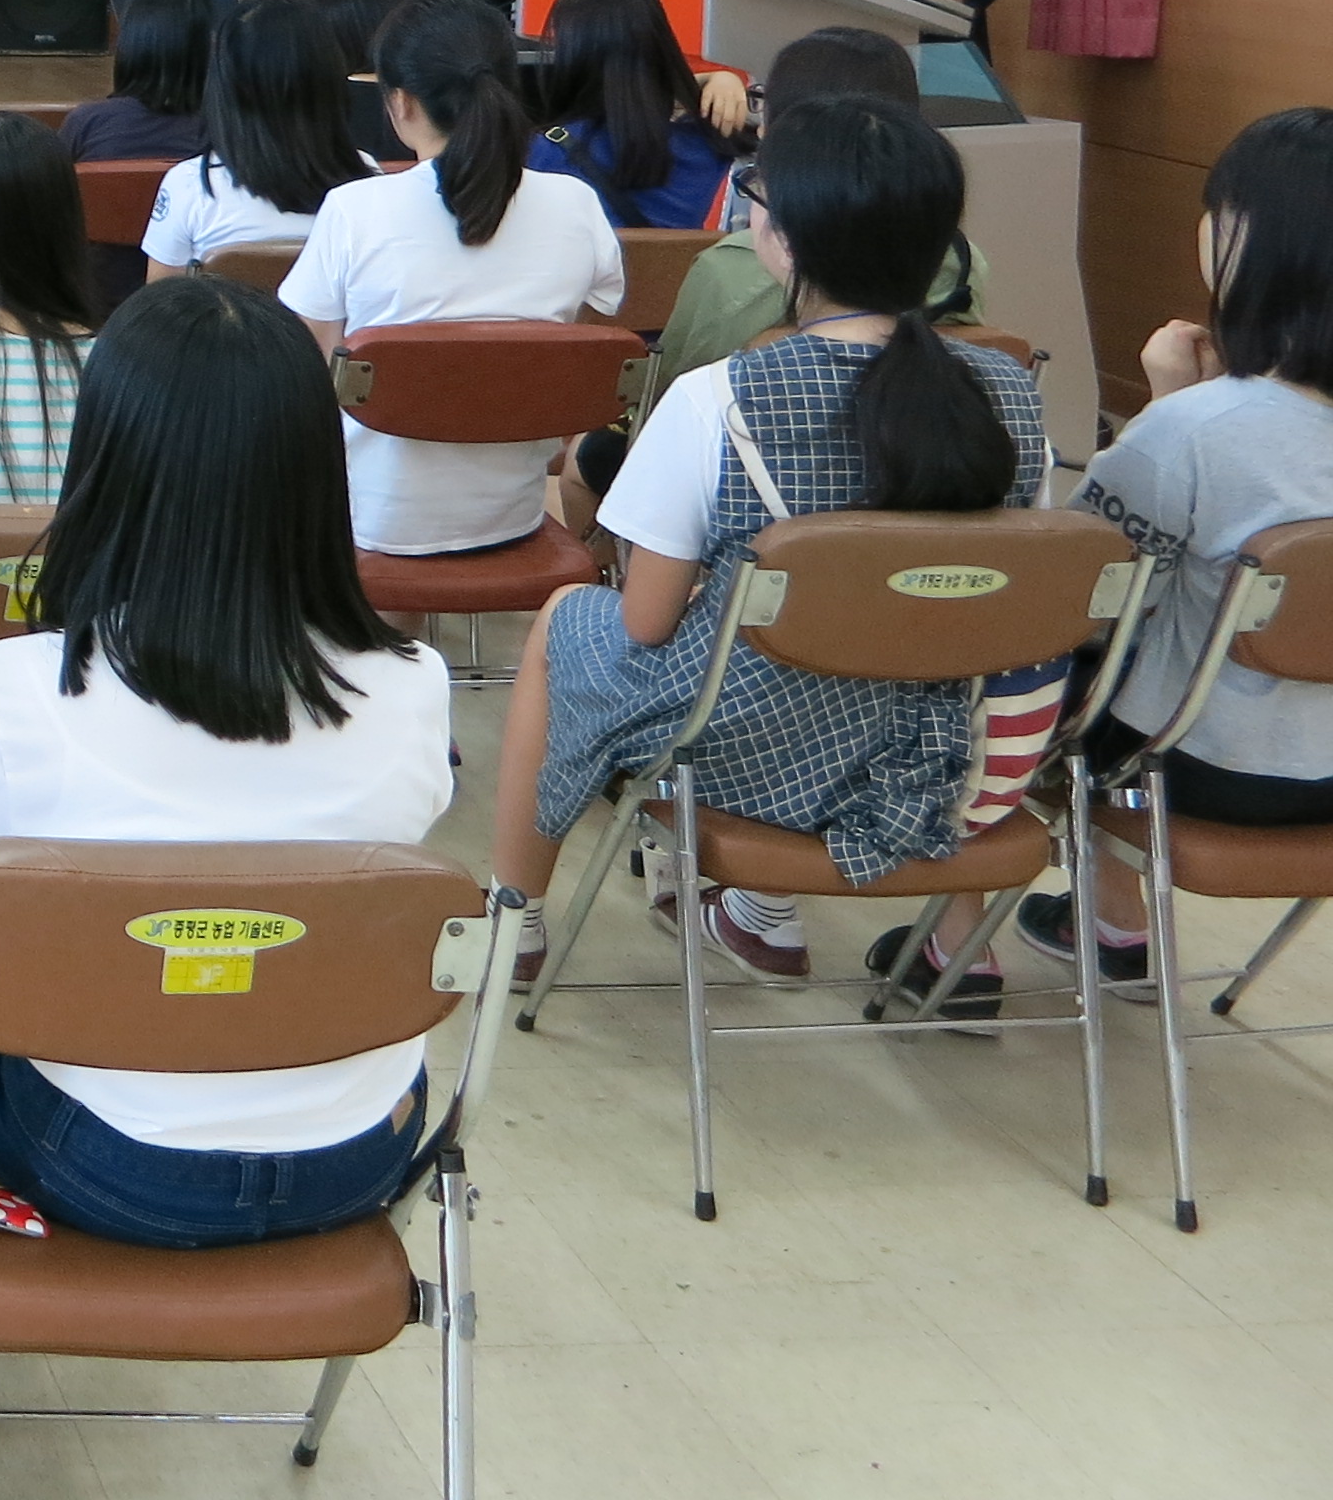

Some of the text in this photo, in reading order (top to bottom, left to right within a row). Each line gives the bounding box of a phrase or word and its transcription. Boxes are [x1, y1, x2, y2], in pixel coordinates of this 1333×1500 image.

[174, 919, 286, 940] 증평군 농업 기술센터
